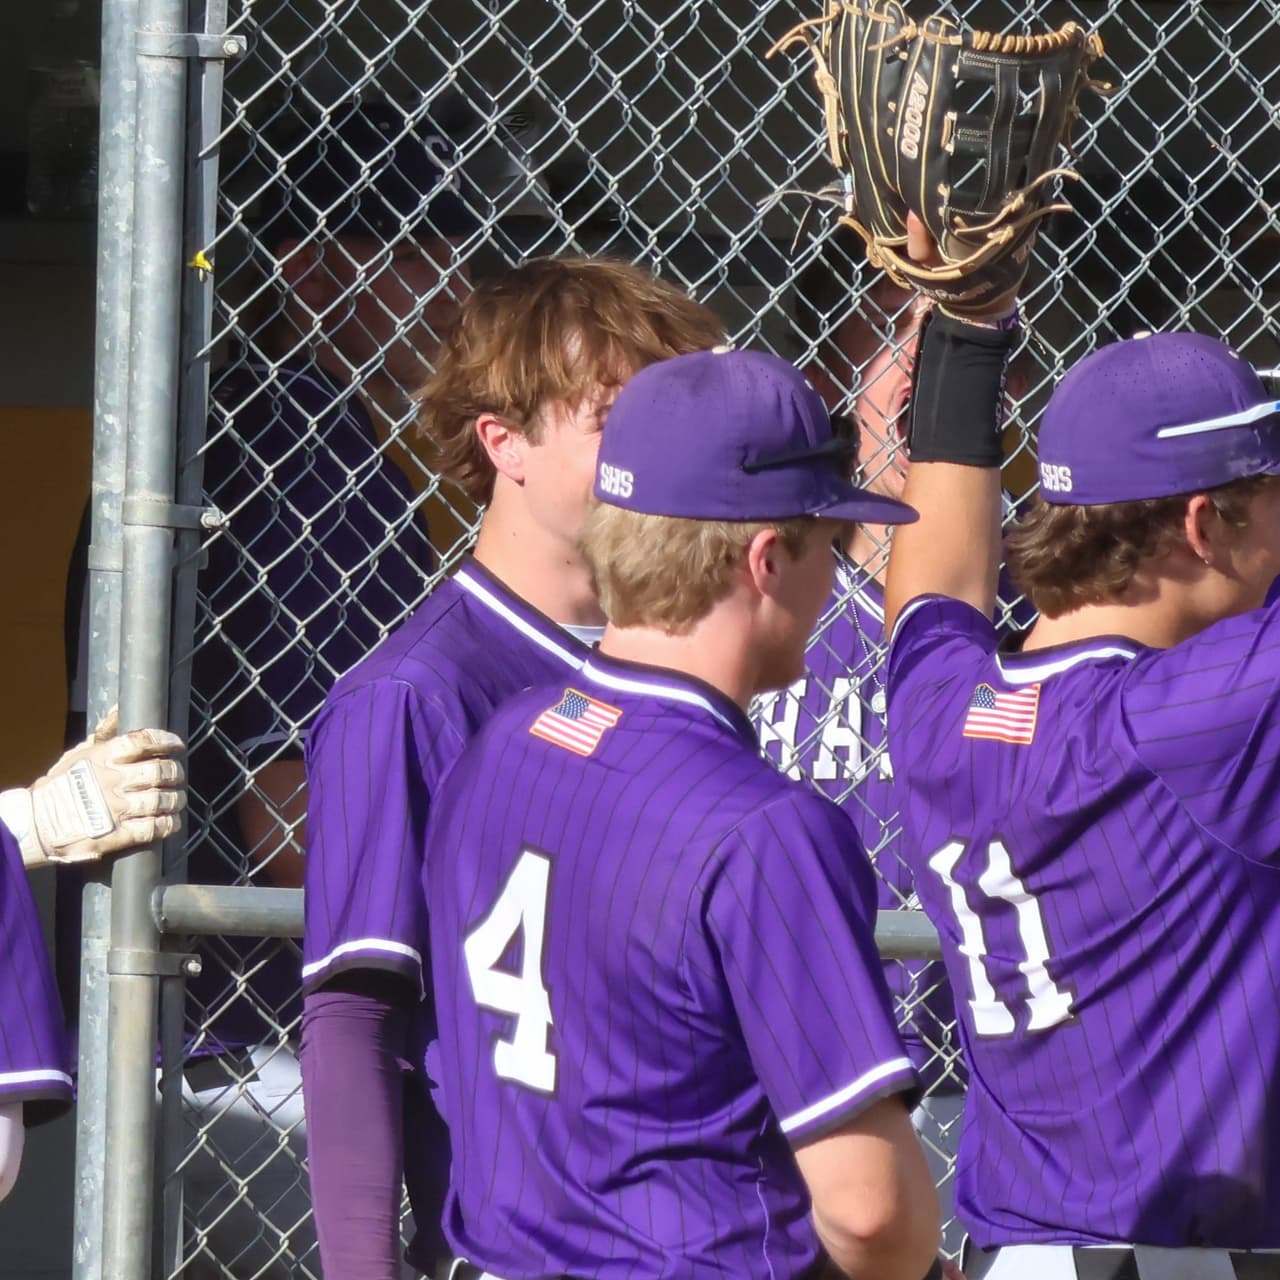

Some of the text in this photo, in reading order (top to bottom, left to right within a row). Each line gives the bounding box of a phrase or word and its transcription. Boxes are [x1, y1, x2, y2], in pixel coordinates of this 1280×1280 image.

[901, 71, 929, 160] A2000
[600, 461, 634, 499] SHS
[1040, 461, 1073, 492] SHS
[748, 678, 894, 781] HA
[463, 849, 557, 1092] 4
[928, 841, 1074, 1034] 11
